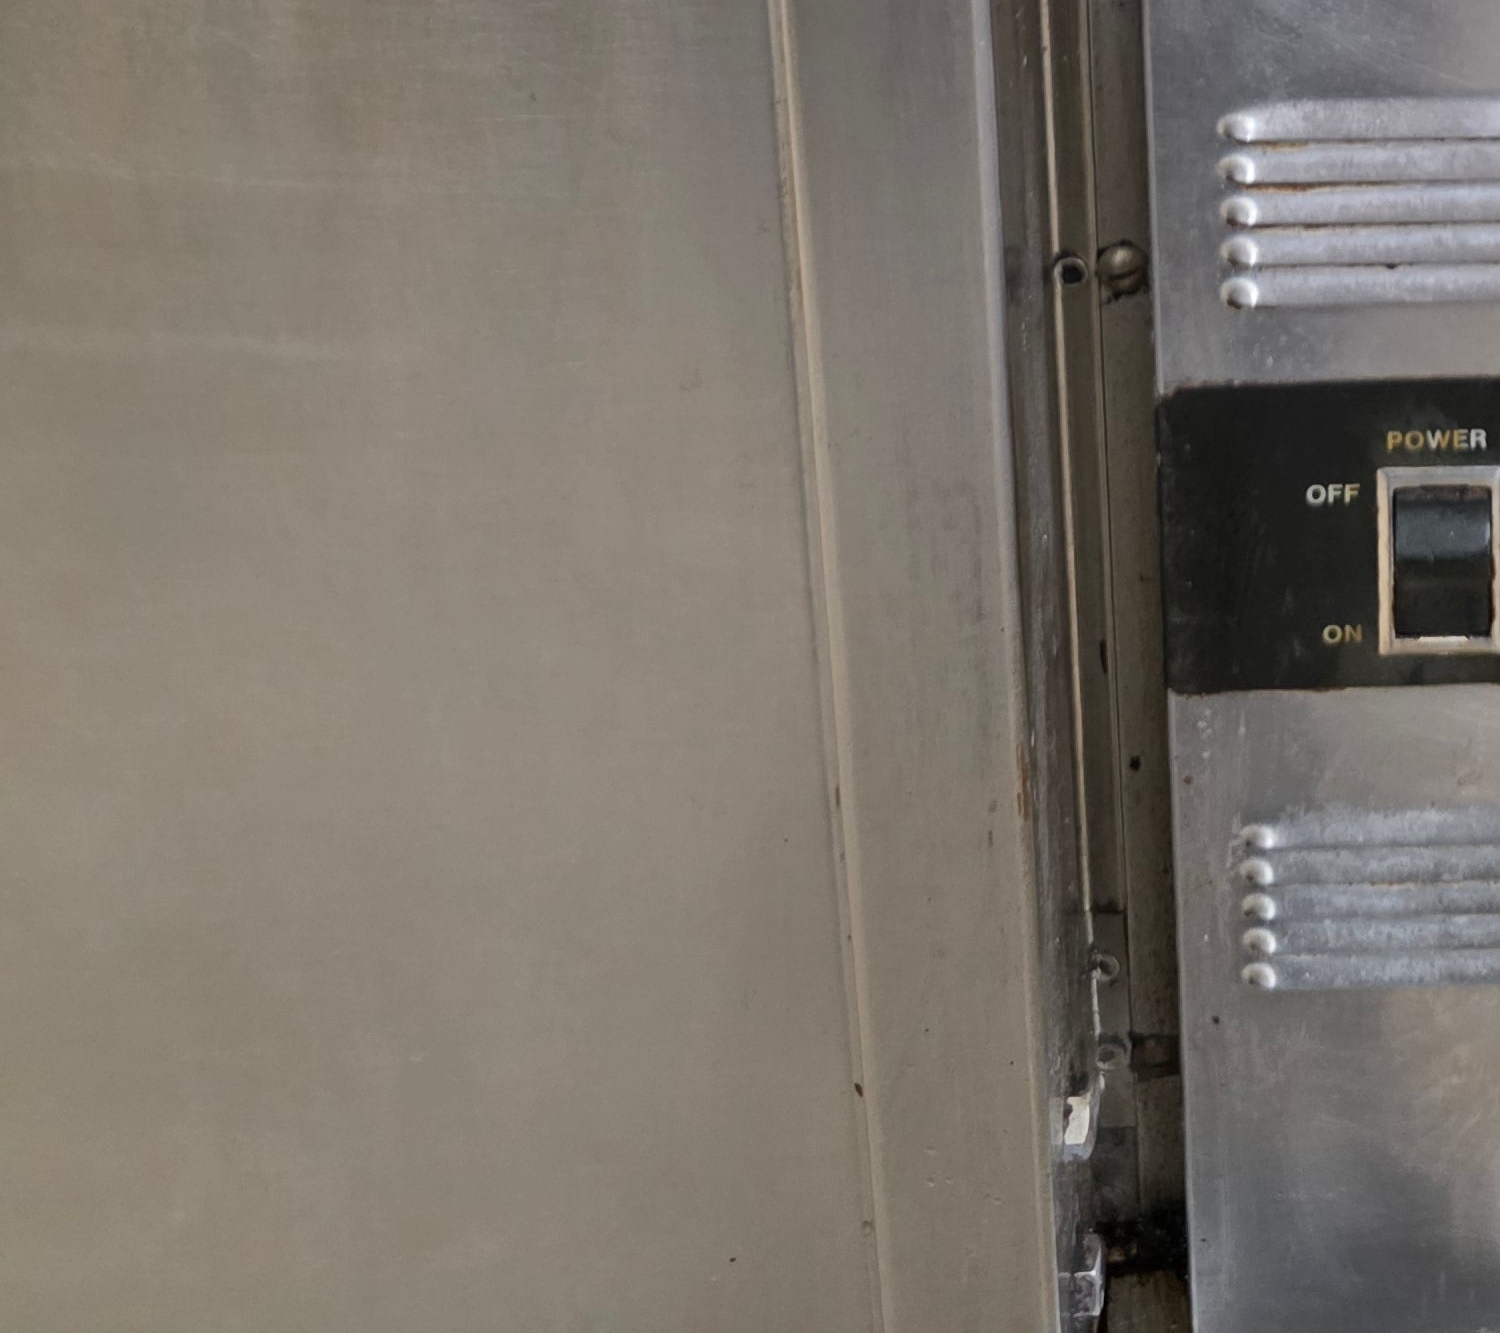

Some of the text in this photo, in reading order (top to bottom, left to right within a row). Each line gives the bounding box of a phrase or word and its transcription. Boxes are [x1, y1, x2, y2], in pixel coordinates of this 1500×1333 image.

[1387, 428, 1488, 451] POWER
[1306, 483, 1360, 506] OFF
[1322, 623, 1363, 645] ON
